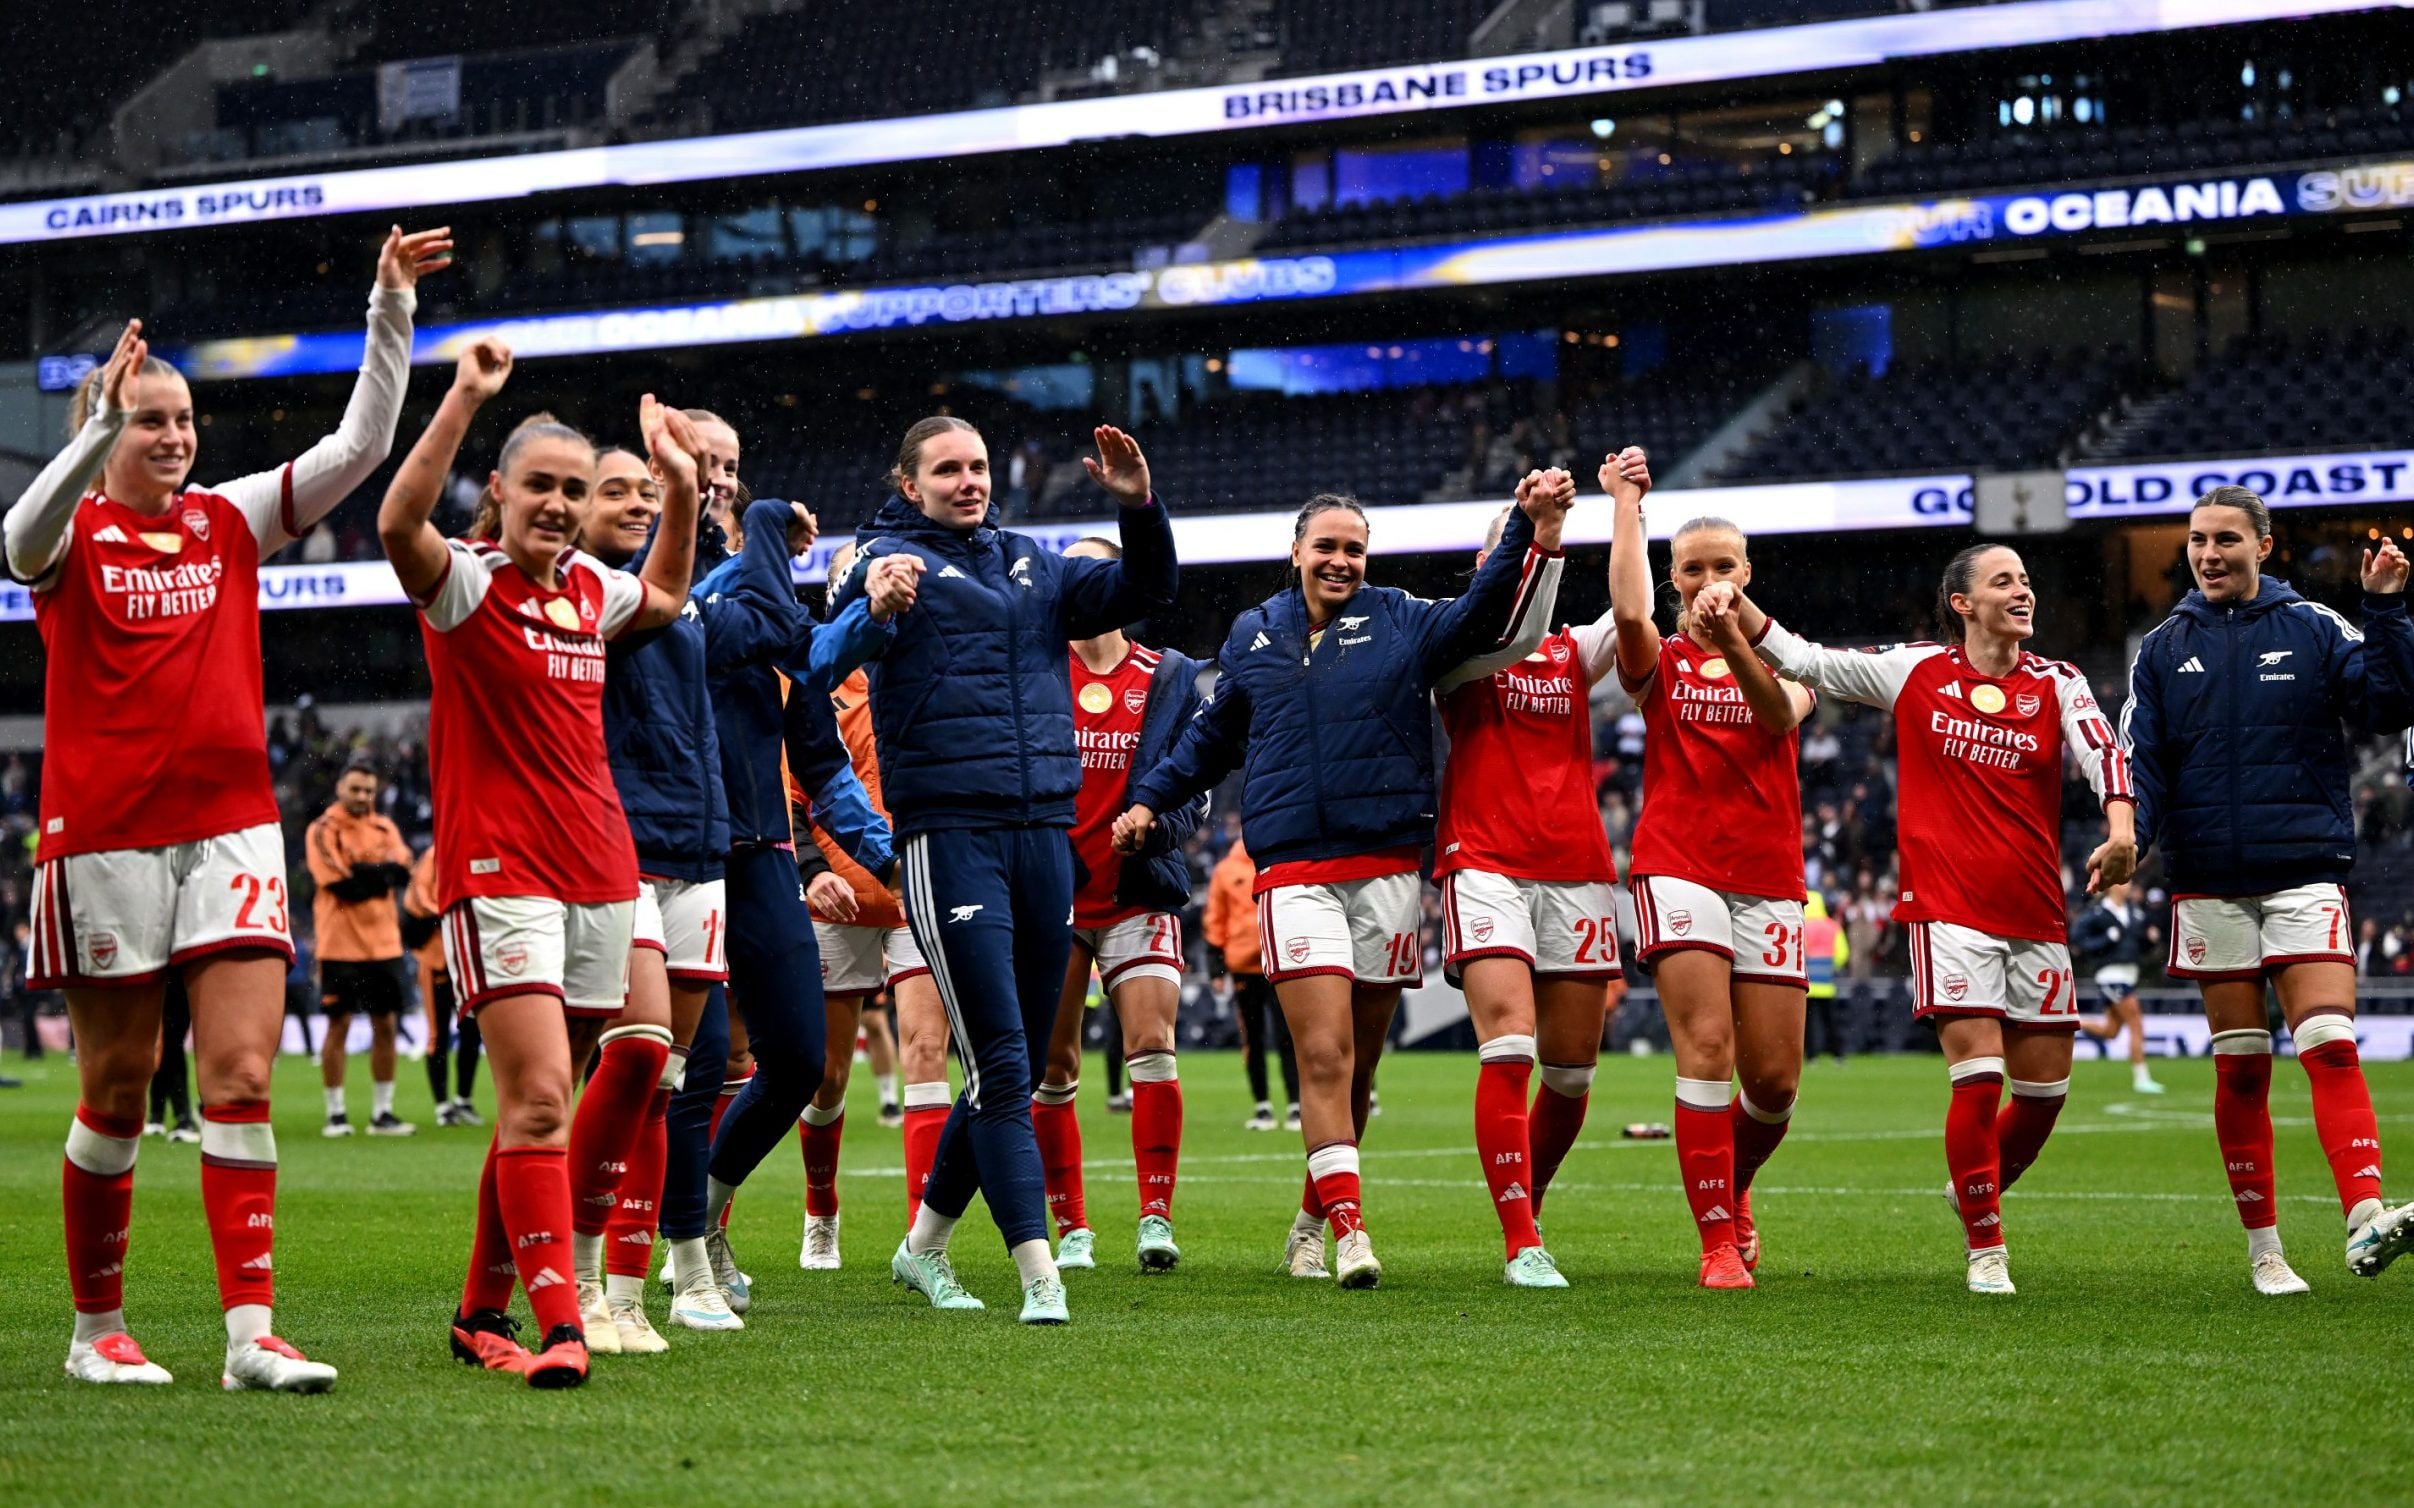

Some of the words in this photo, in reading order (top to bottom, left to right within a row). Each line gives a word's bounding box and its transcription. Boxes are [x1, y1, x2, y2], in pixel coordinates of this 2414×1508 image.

[1223, 72, 1468, 119] BRISBANE
[1483, 52, 1654, 93] SPURS
[46, 199, 184, 230] CAIRNS
[197, 185, 324, 215] SPURS
[2004, 177, 2285, 236] OCEANIA
[1157, 255, 1338, 305] CLUBS
[2190, 461, 2409, 498] COAST
[101, 554, 222, 593] Emirates
[261, 574, 345, 599] URS
[127, 593, 156, 619] FLY
[1338, 634, 1372, 646] Emirates
[547, 653, 569, 679] FLY
[2259, 672, 2296, 681] Emirates
[1506, 692, 1528, 711] FLY
[1531, 696, 1571, 715] BETTER
[1672, 679, 1744, 703] Emirat
[1680, 703, 1702, 720] FLY
[1705, 704, 1753, 724] BETTER
[1931, 710, 2038, 752] Emirates
[1074, 726, 1141, 749] irates
[1943, 737, 1969, 758] FLY
[1969, 744, 2021, 770] BETTER
[1081, 751, 1127, 770] BETTER
[230, 872, 287, 934] 23
[1573, 916, 1617, 964] 25
[2321, 906, 2341, 950] 7
[1385, 931, 1417, 977] 19
[1763, 922, 1802, 972] 31
[1699, 1178, 1725, 1190] AFC
